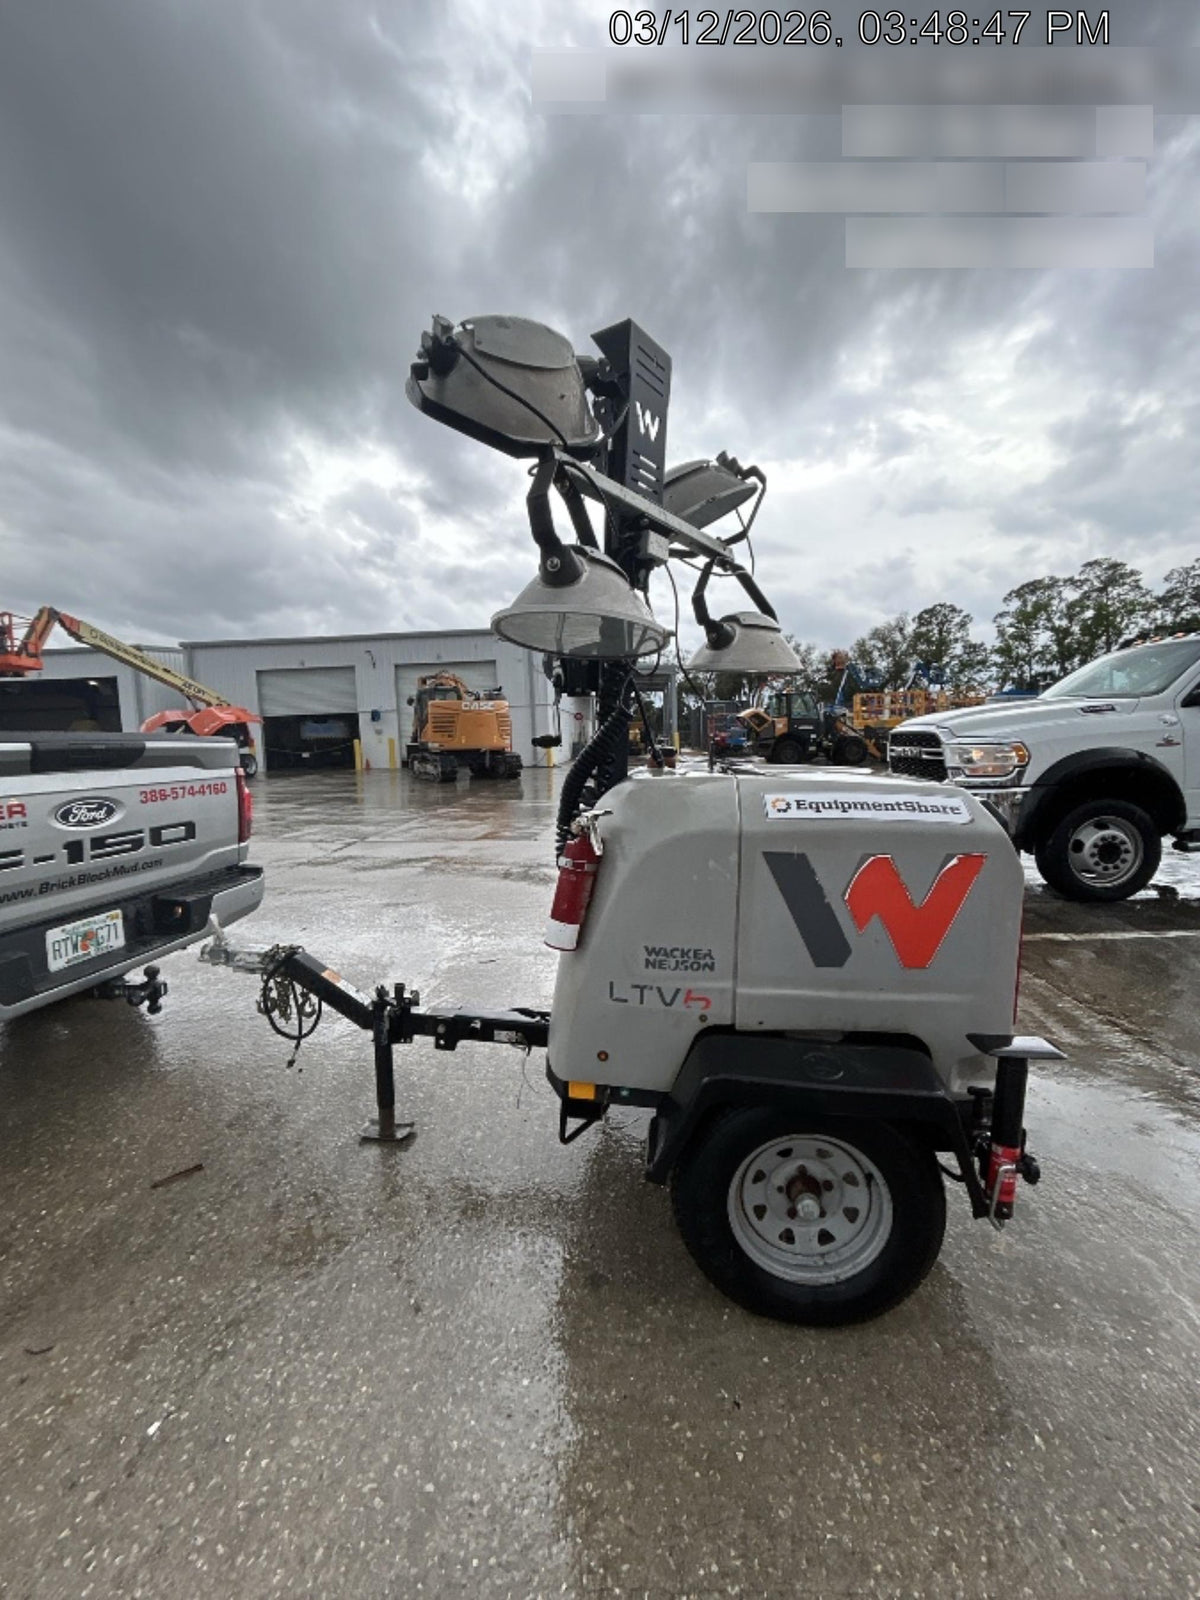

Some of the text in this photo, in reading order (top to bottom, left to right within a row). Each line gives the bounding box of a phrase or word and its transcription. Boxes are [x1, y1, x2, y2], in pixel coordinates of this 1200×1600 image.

[461, 701, 495, 710] CASE
[0, 803, 27, 820] R
[69, 804, 107, 823] Ford
[795, 799, 962, 816] EquipmentShare
